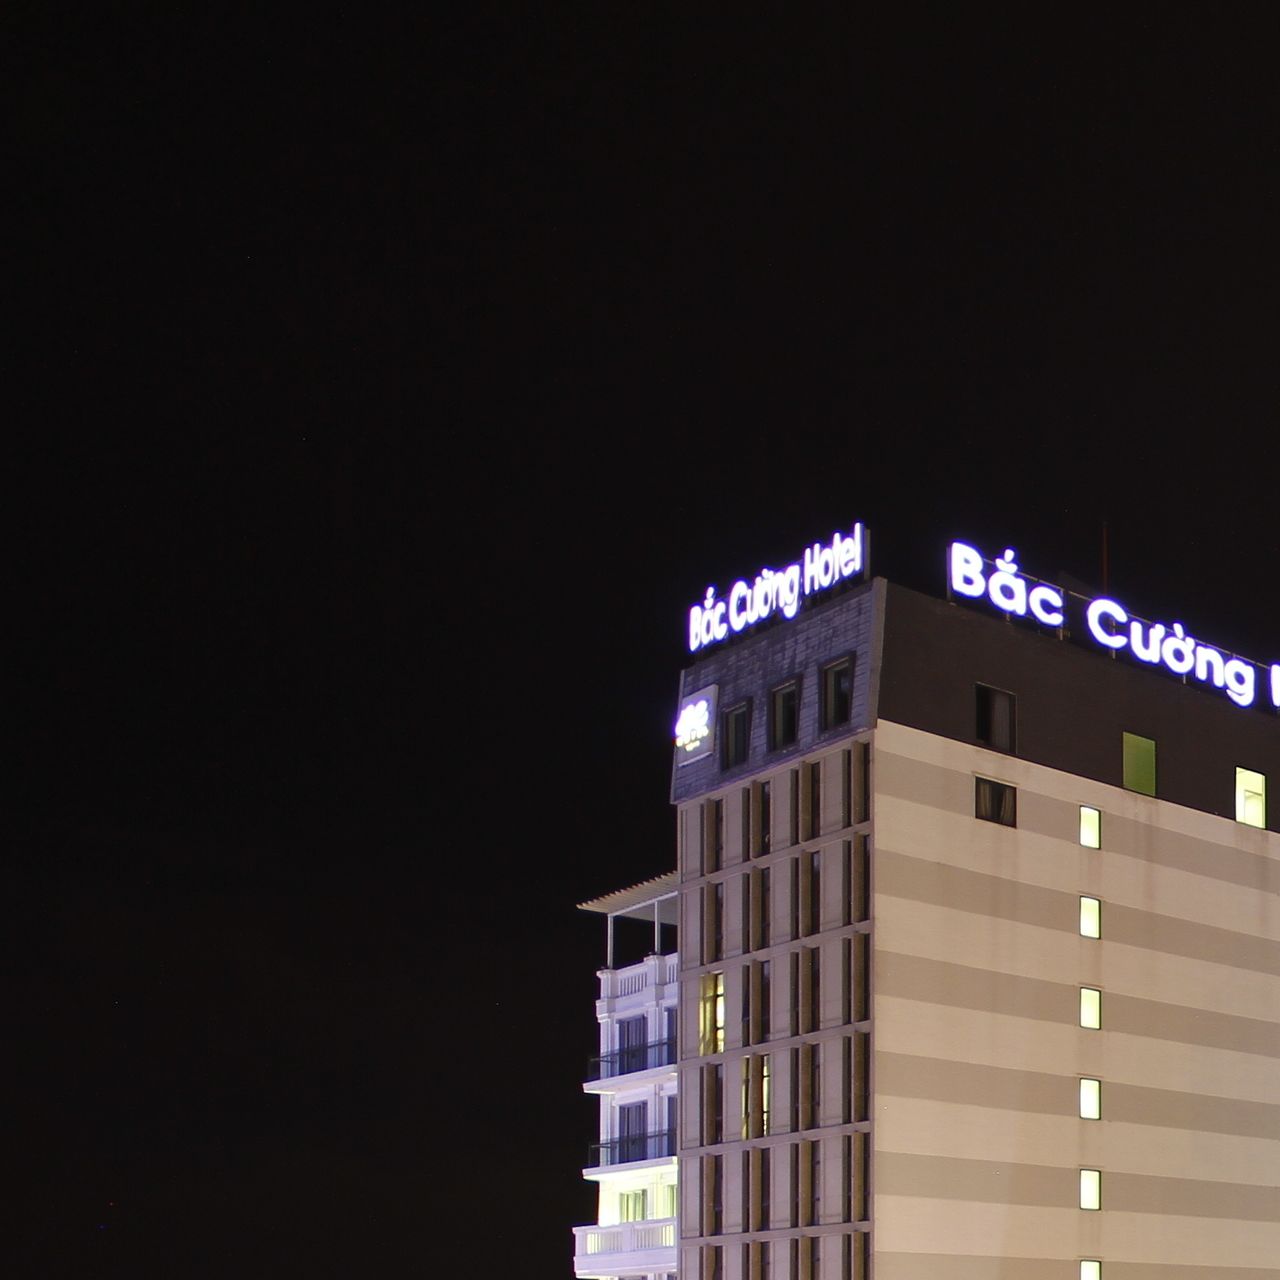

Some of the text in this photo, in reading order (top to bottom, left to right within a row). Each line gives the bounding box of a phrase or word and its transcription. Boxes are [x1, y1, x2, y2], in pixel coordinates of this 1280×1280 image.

[689, 522, 862, 651] Bắc Cường Hotel
[951, 542, 1063, 627] Bắc
[1087, 599, 1256, 708] Cường
